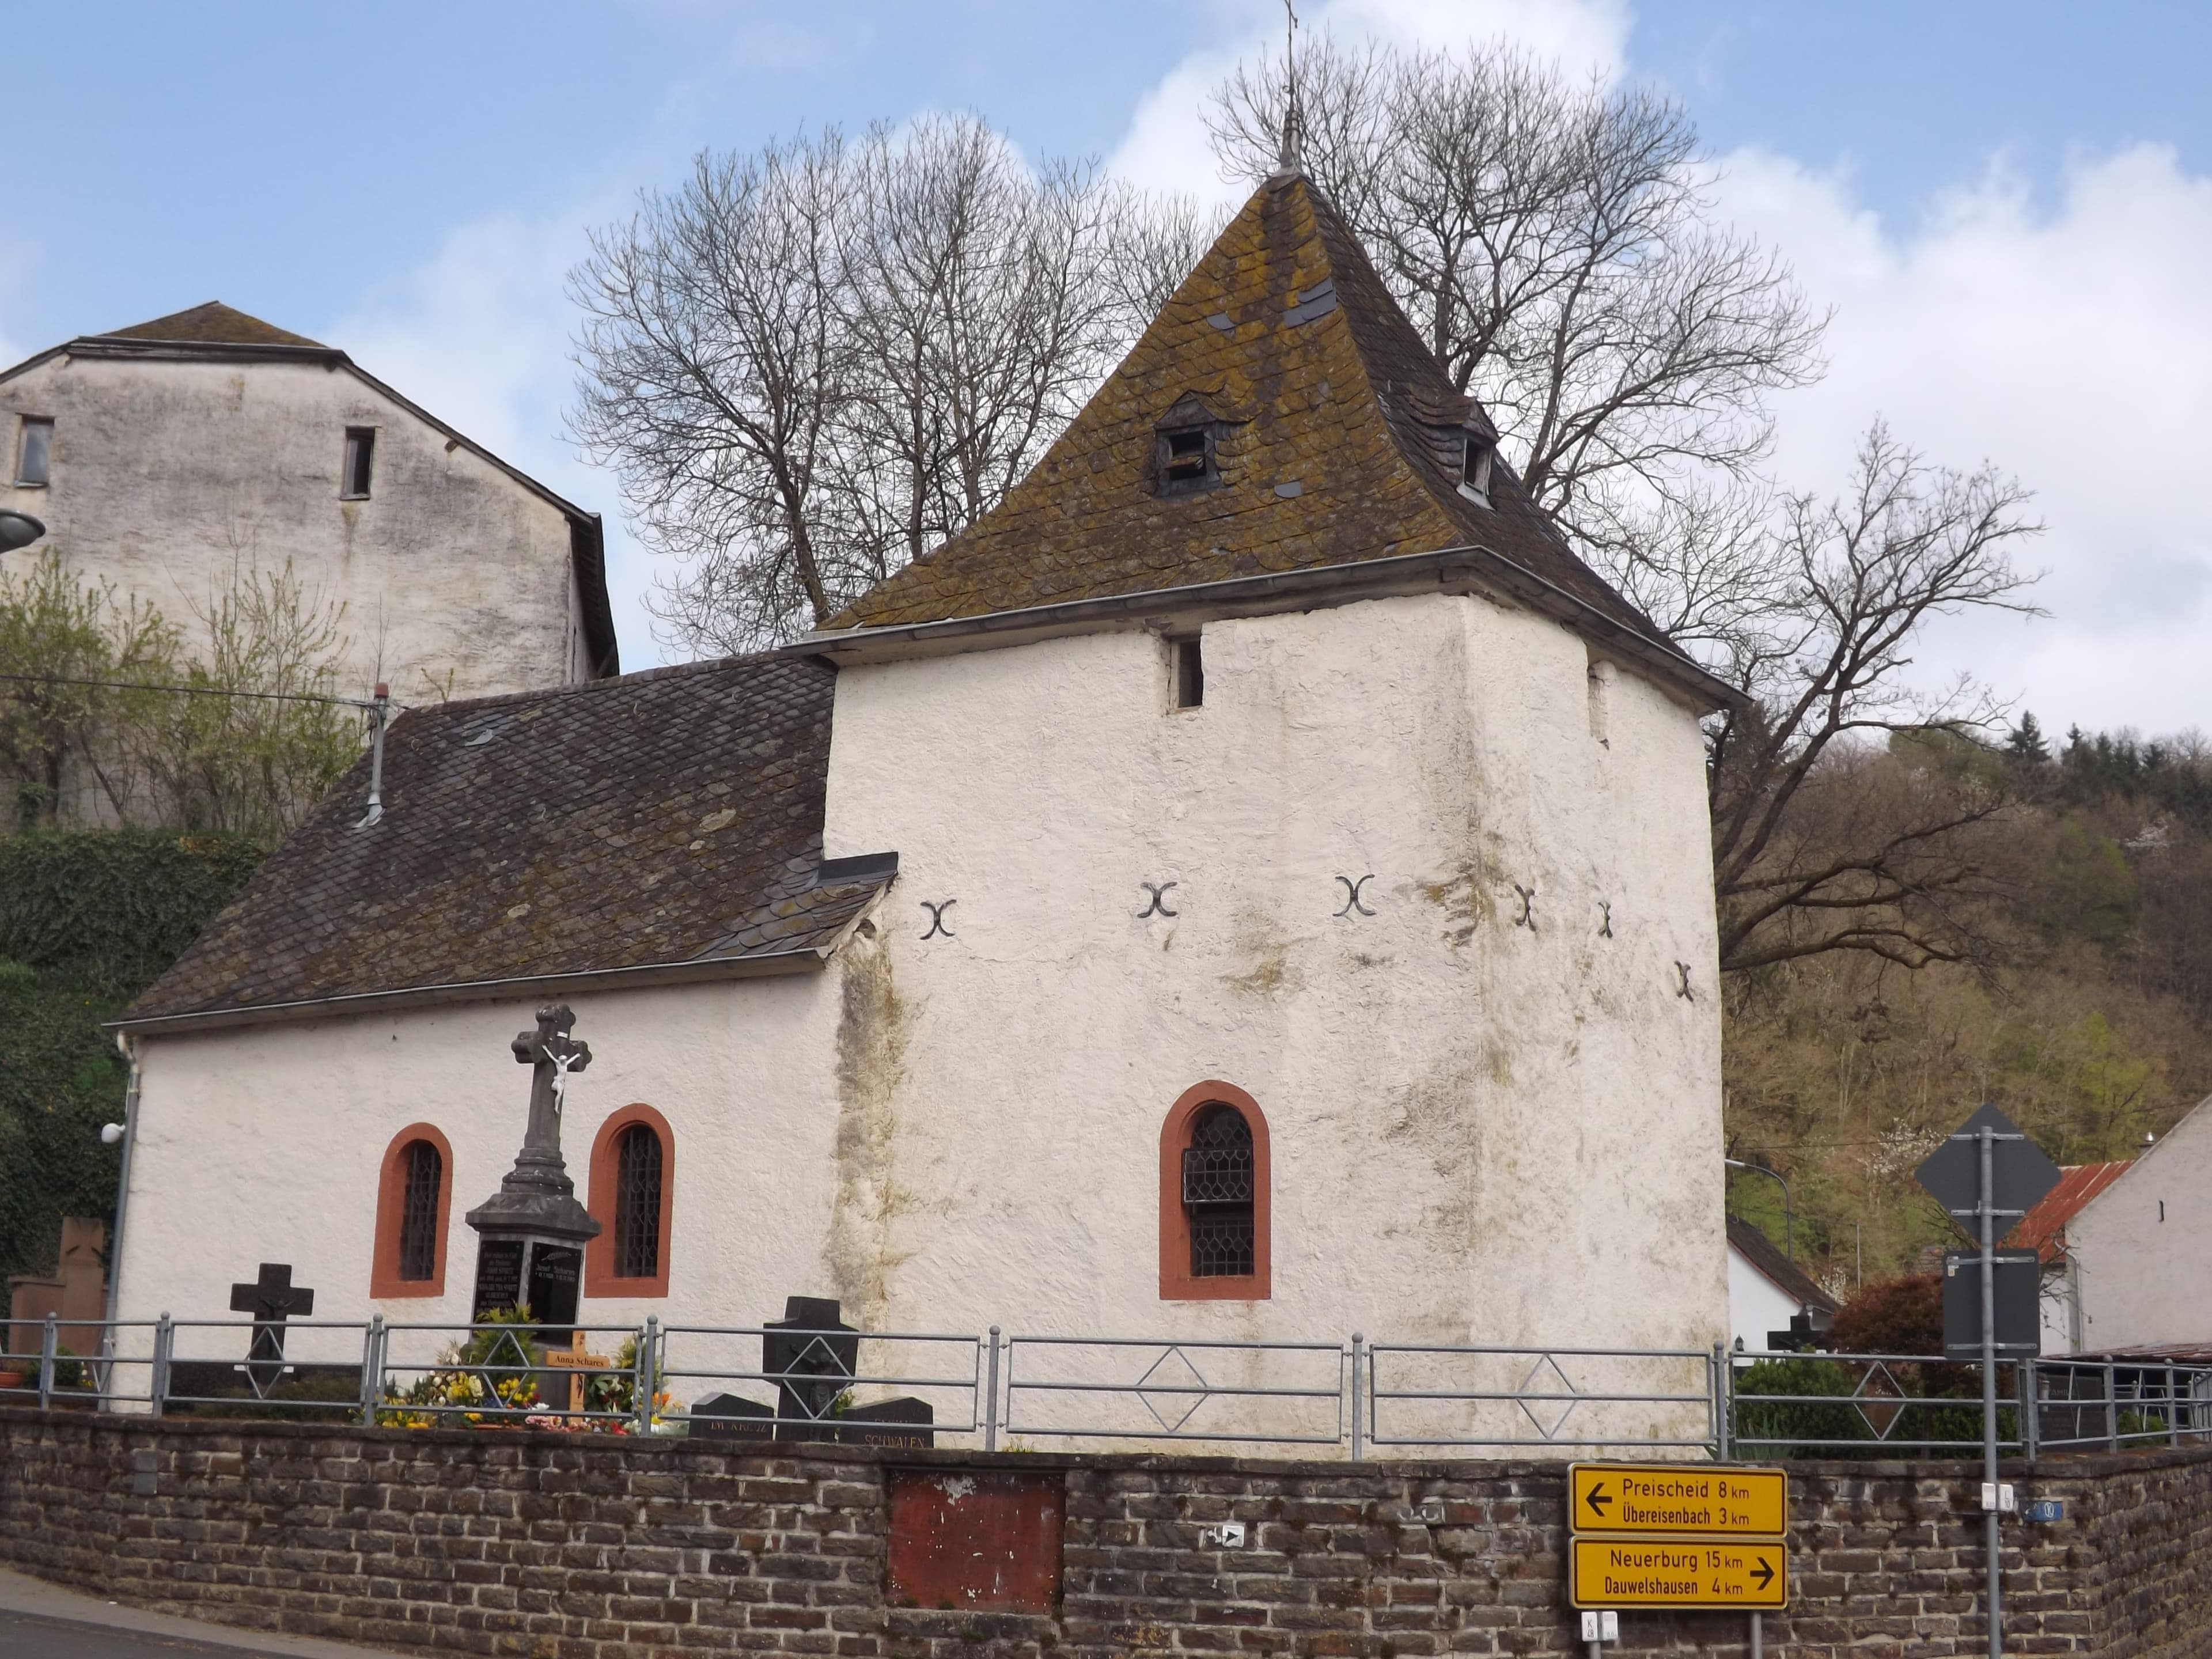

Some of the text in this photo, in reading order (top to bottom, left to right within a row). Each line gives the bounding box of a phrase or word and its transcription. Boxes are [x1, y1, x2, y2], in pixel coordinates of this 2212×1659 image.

[555, 1355, 604, 1367] Anna Schares
[1623, 1478, 1749, 1499] Preischeid 8 km
[1623, 1501, 1749, 1525] Übereisenbach 3 km
[1611, 1549, 1743, 1573] Neuerburg 15 km
[1605, 1576, 1743, 1595] Dauwelshausen 4 km
[1587, 1619, 1593, 1628] K
